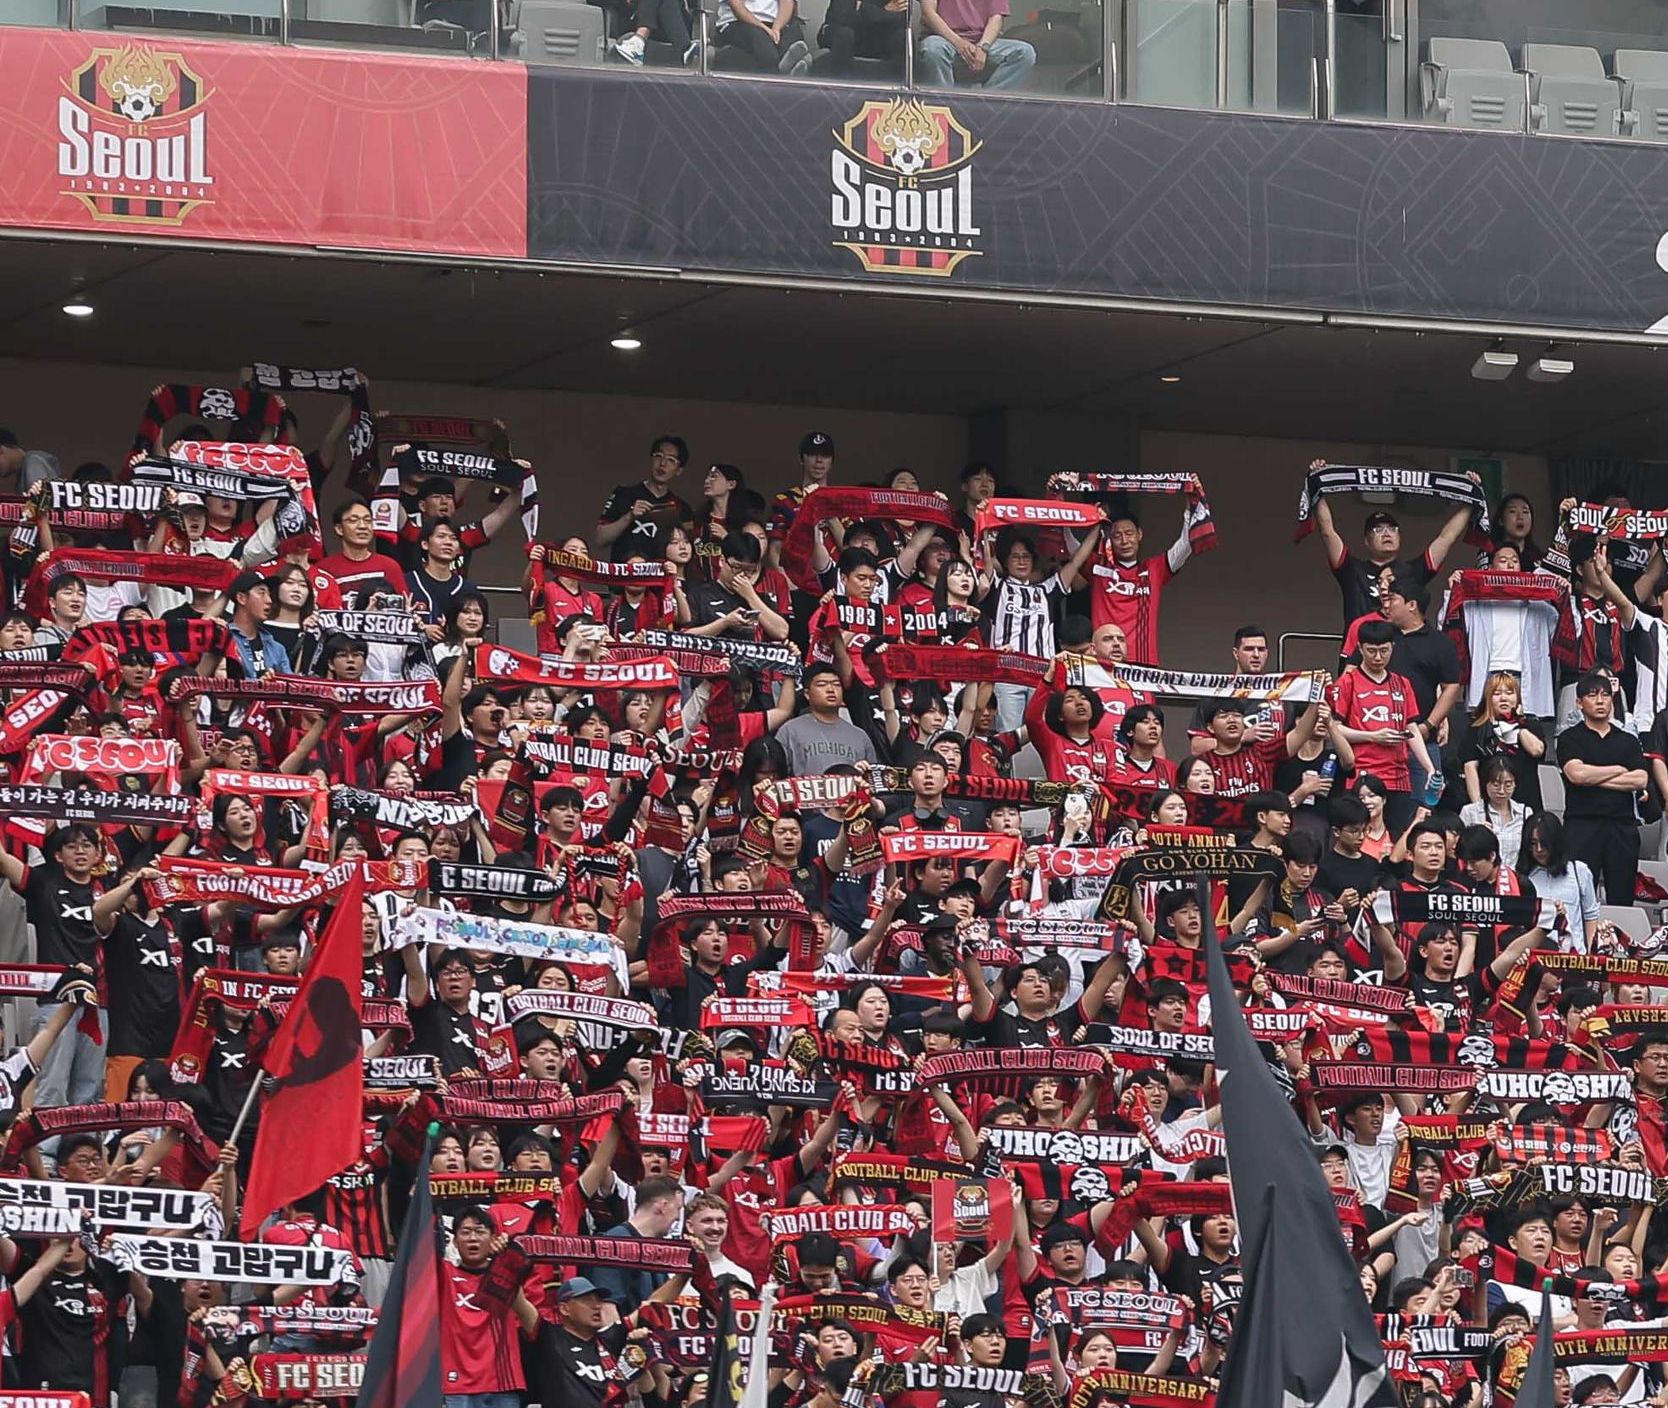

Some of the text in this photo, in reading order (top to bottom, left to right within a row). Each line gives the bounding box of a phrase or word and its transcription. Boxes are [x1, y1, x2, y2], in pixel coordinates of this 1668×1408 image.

[127, 124, 151, 135] FC
[59, 101, 213, 184] Seoul
[898, 177, 919, 188] FC
[833, 152, 980, 236] Seoul
[417, 450, 496, 470] FC SEOUL
[421, 464, 495, 478] SOUL SEOUL
[1359, 471, 1430, 489] FC SEOUL
[174, 470, 244, 492] FC SEOUL
[52, 482, 88, 509] FC
[995, 507, 1084, 523] FC SEOUL
[1570, 508, 1602, 528] SOUL
[839, 606, 948, 633] 1983 2004
[541, 664, 673, 680] FC SEOUL
[1114, 668, 1282, 692] FOOTBALL CLUB SEOUL
[80, 795, 119, 810] 우리가
[892, 837, 988, 853] FC SEOUL
[1143, 853, 1256, 871] GO YOHAN
[1428, 895, 1501, 912] FC SEOUL
[1428, 910, 1503, 922] SOUL SEOUL
[1538, 955, 1600, 972] FOOTBALL
[1606, 957, 1634, 973] CLUB
[507, 995, 651, 1025] FOOTBALL CLUB SEOUL
[1513, 1138, 1549, 1149] FC SEOUL
[1570, 1143, 1604, 1155] 신한카드
[1544, 1166, 1656, 1202] FC SEOUL
[3, 1208, 81, 1232] SHIN
[139, 1240, 335, 1280] 승점 고맙구나
[904, 1365, 1022, 1393] FC SEOUL
[1098, 1373, 1205, 1397] ANNIVERSARY
